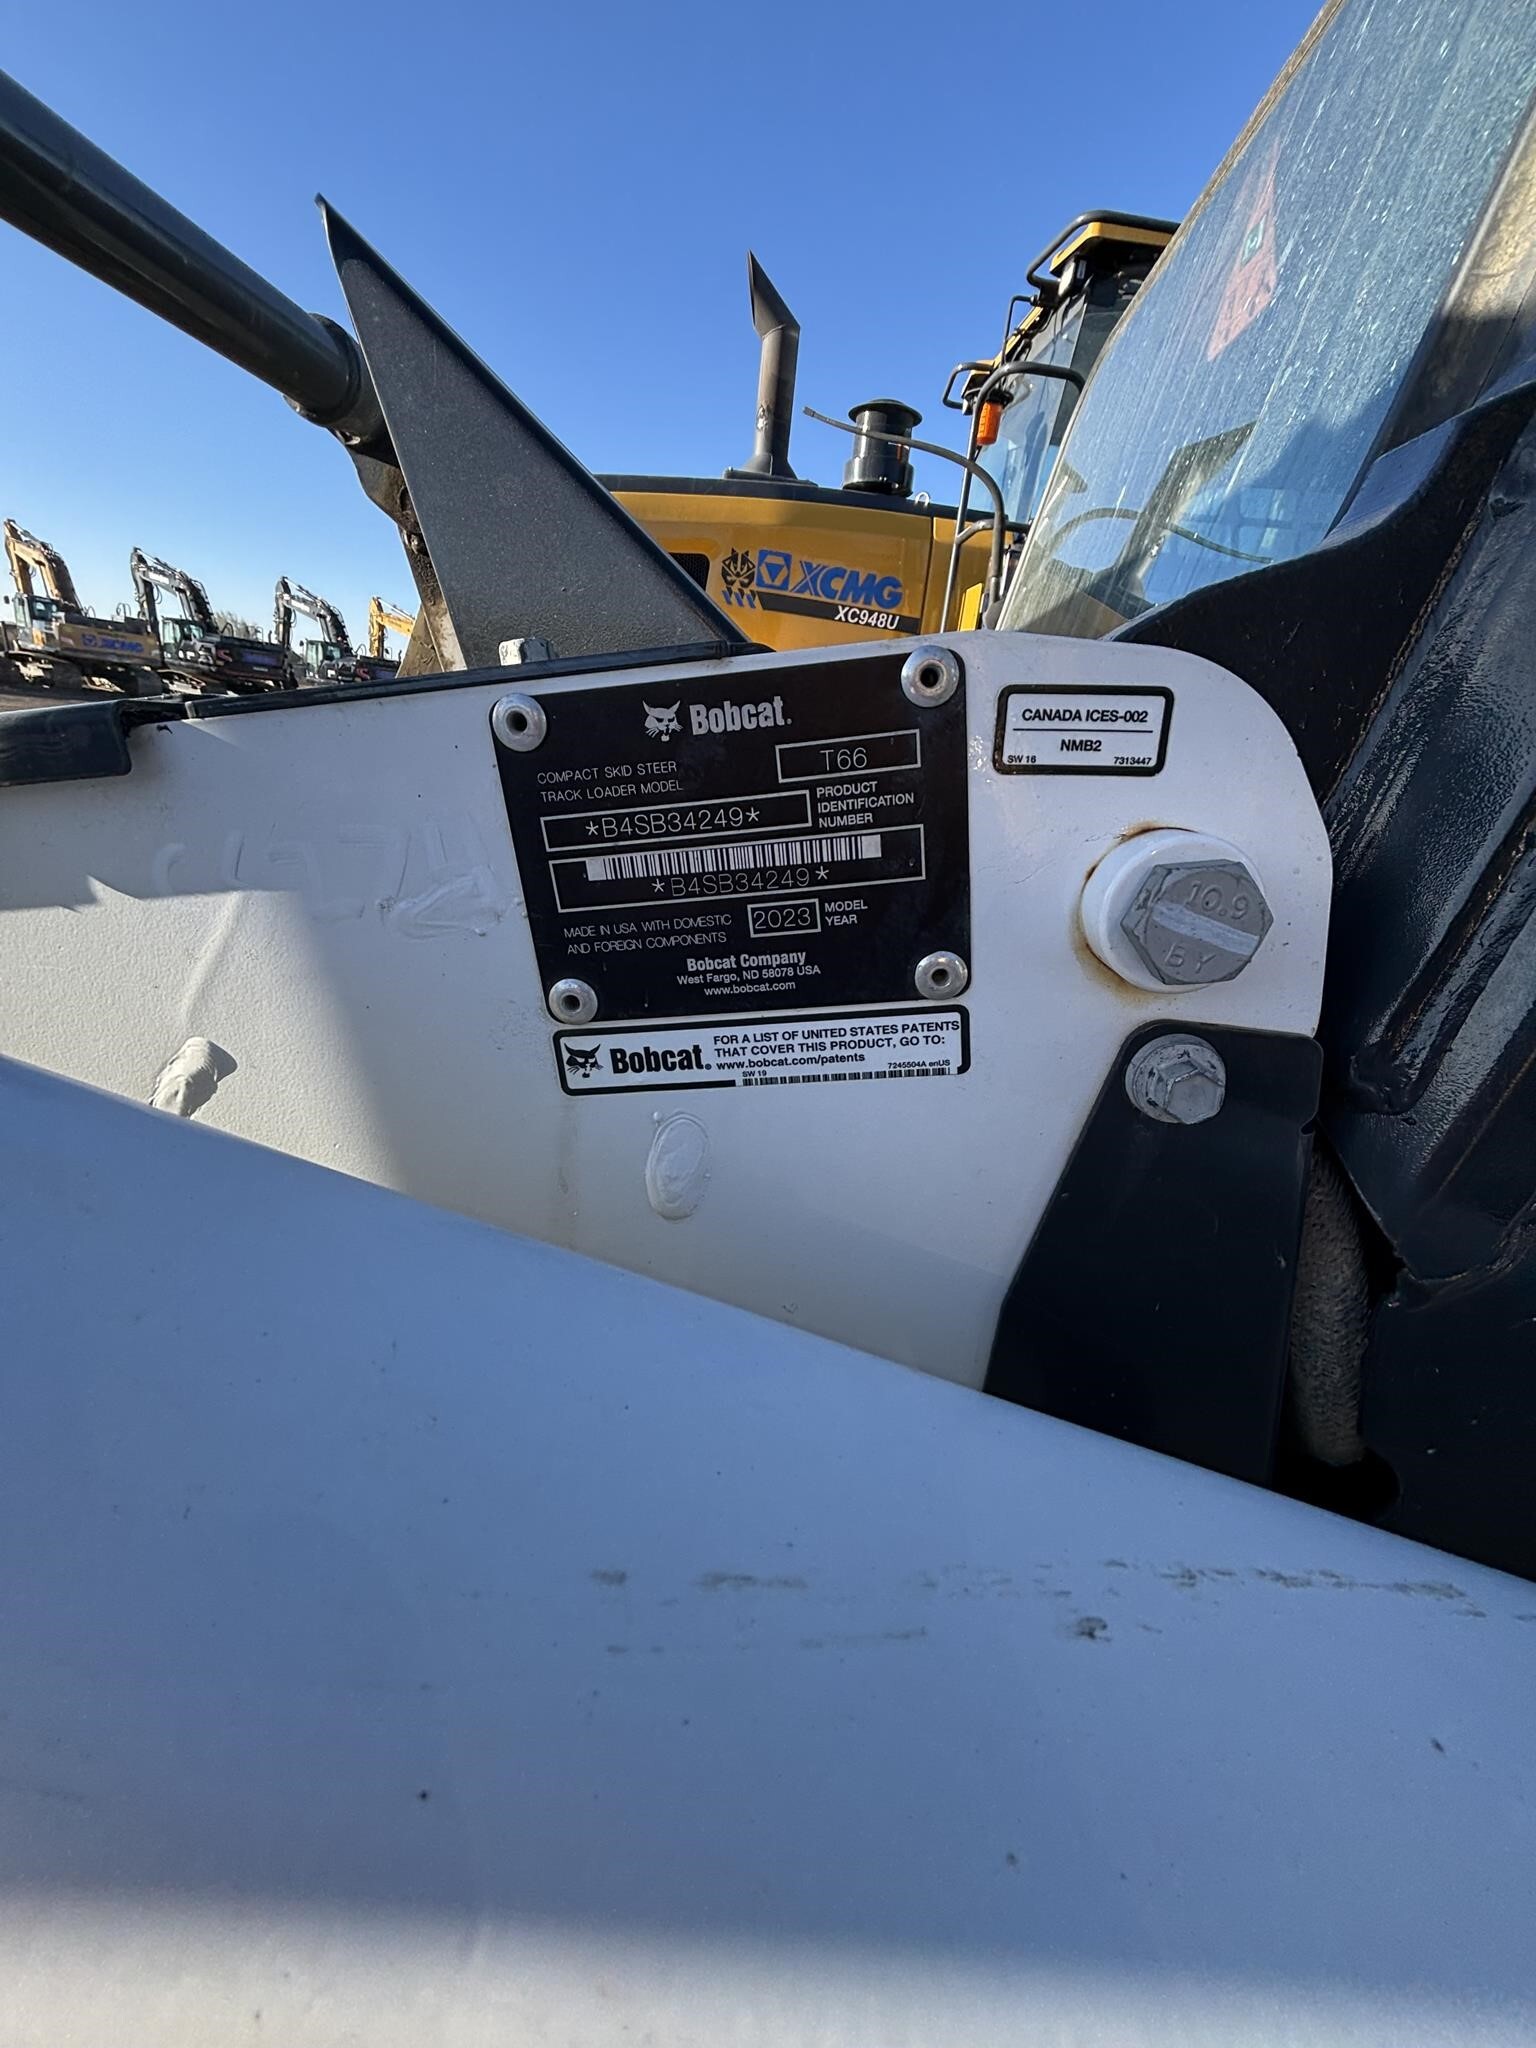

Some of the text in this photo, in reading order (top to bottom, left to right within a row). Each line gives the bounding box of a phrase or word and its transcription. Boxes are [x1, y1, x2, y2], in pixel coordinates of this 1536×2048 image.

[791, 560, 903, 609] XCMG
[834, 605, 900, 630] XC948U
[1021, 709, 1149, 723] CANADA ICES-002
[1060, 739, 1103, 752] NMB2
[819, 747, 868, 771] T66
[1007, 755, 1024, 764] SW
[1113, 756, 1152, 766] 7313447
[537, 761, 678, 785] COMPACT SKID STEER
[540, 780, 684, 803] TRACK LOADER MODEL
[816, 781, 878, 799] PRODUCT
[817, 793, 915, 814] IDENTIFICATION
[818, 812, 873, 829] NUMBER
[824, 899, 868, 913] MODEL
[1184, 881, 1249, 920] 10.9
[563, 914, 732, 939] MADE IN USA WITH DOMESTIC
[753, 907, 811, 930] 2023
[825, 914, 858, 927] YEAR
[567, 932, 727, 955] AND FOREIGN COMPONENTS
[686, 952, 807, 972] Bobcat Company
[676, 965, 821, 986] West Fargo, ND 58078 USA
[704, 980, 796, 997] www.bobcat.com
[713, 1020, 960, 1046] FOR A LIST OF UNITED STATES PATENTS
[714, 1034, 945, 1058] THAT COVER THIS PRODUCT, GO TO:
[716, 1053, 865, 1071] www.bobcat.com/patents
[742, 1069, 767, 1078] SW 19
